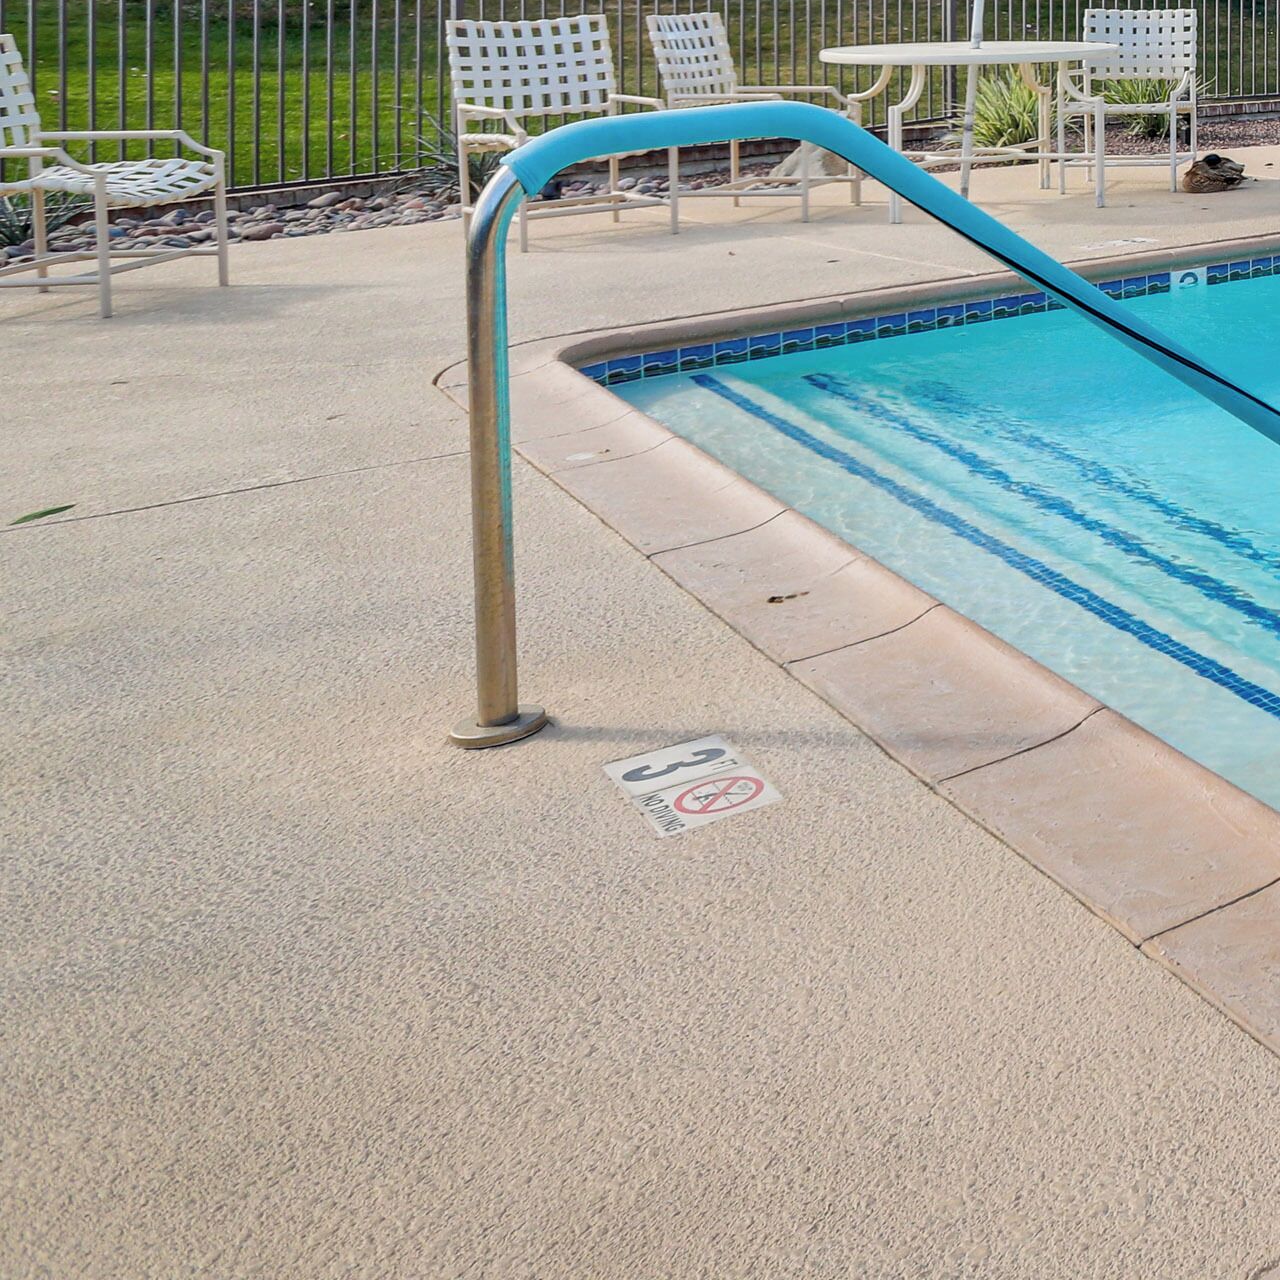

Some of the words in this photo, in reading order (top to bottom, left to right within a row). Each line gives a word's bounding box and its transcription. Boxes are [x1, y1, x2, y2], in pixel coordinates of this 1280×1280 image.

[621, 748, 726, 782] 3
[709, 758, 738, 771] FT
[640, 793, 664, 808] NO
[649, 804, 687, 832] DIVING
